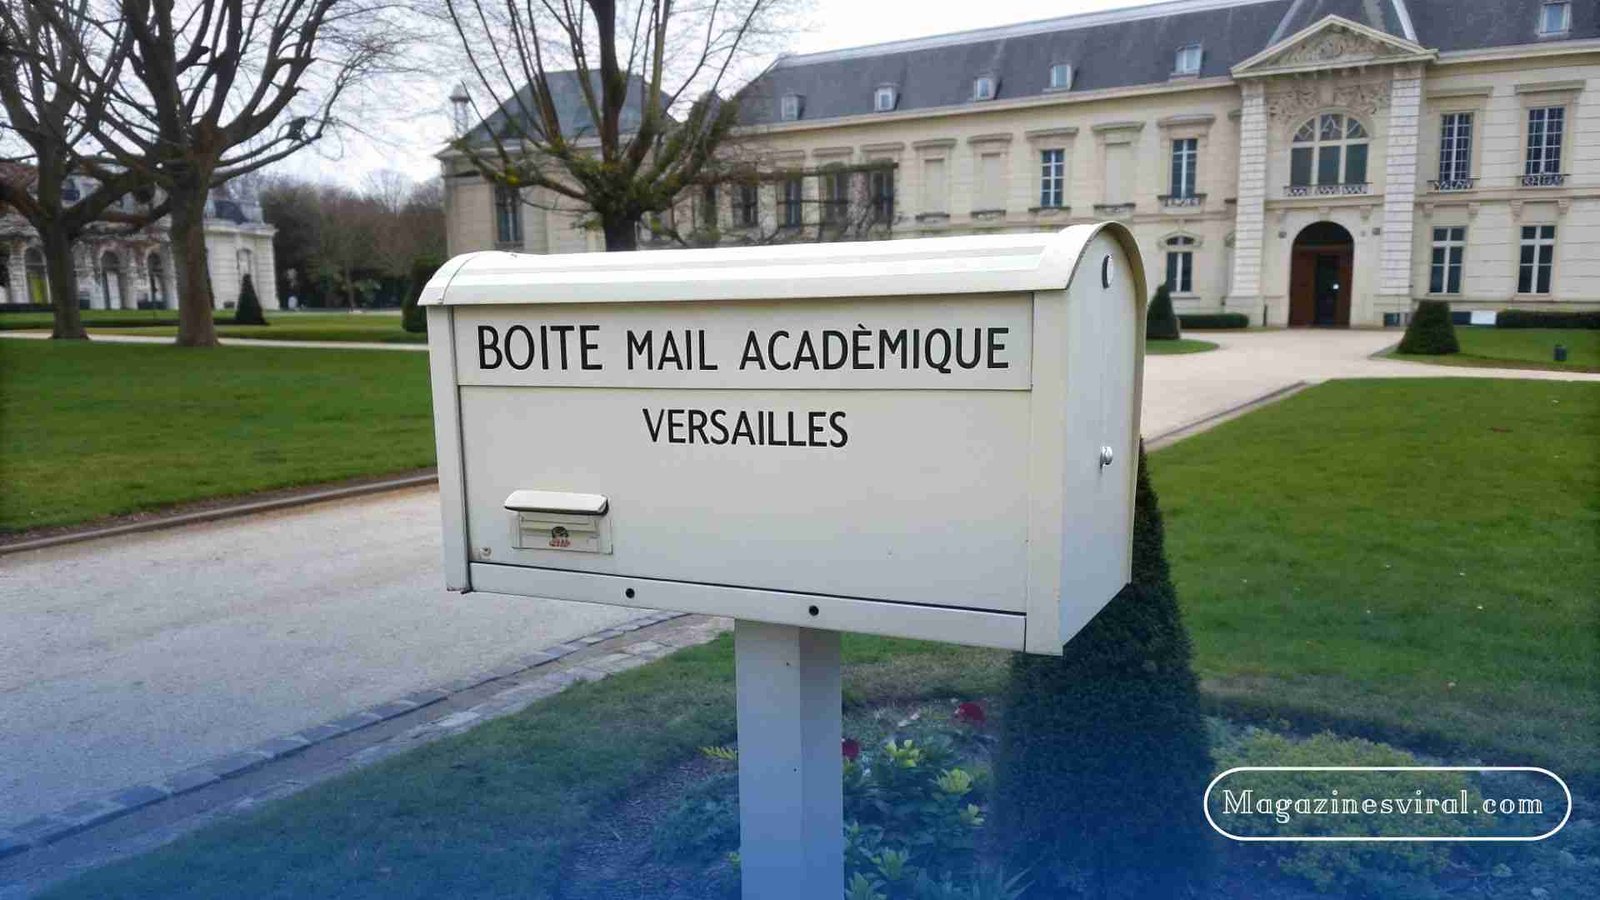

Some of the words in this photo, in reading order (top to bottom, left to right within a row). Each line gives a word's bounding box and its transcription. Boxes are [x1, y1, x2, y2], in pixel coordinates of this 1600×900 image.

[477, 324, 603, 371] BOITE
[626, 329, 718, 371] MAIL
[739, 323, 1010, 374] ACADÈMIQUE
[642, 408, 849, 448] VERSAILLES
